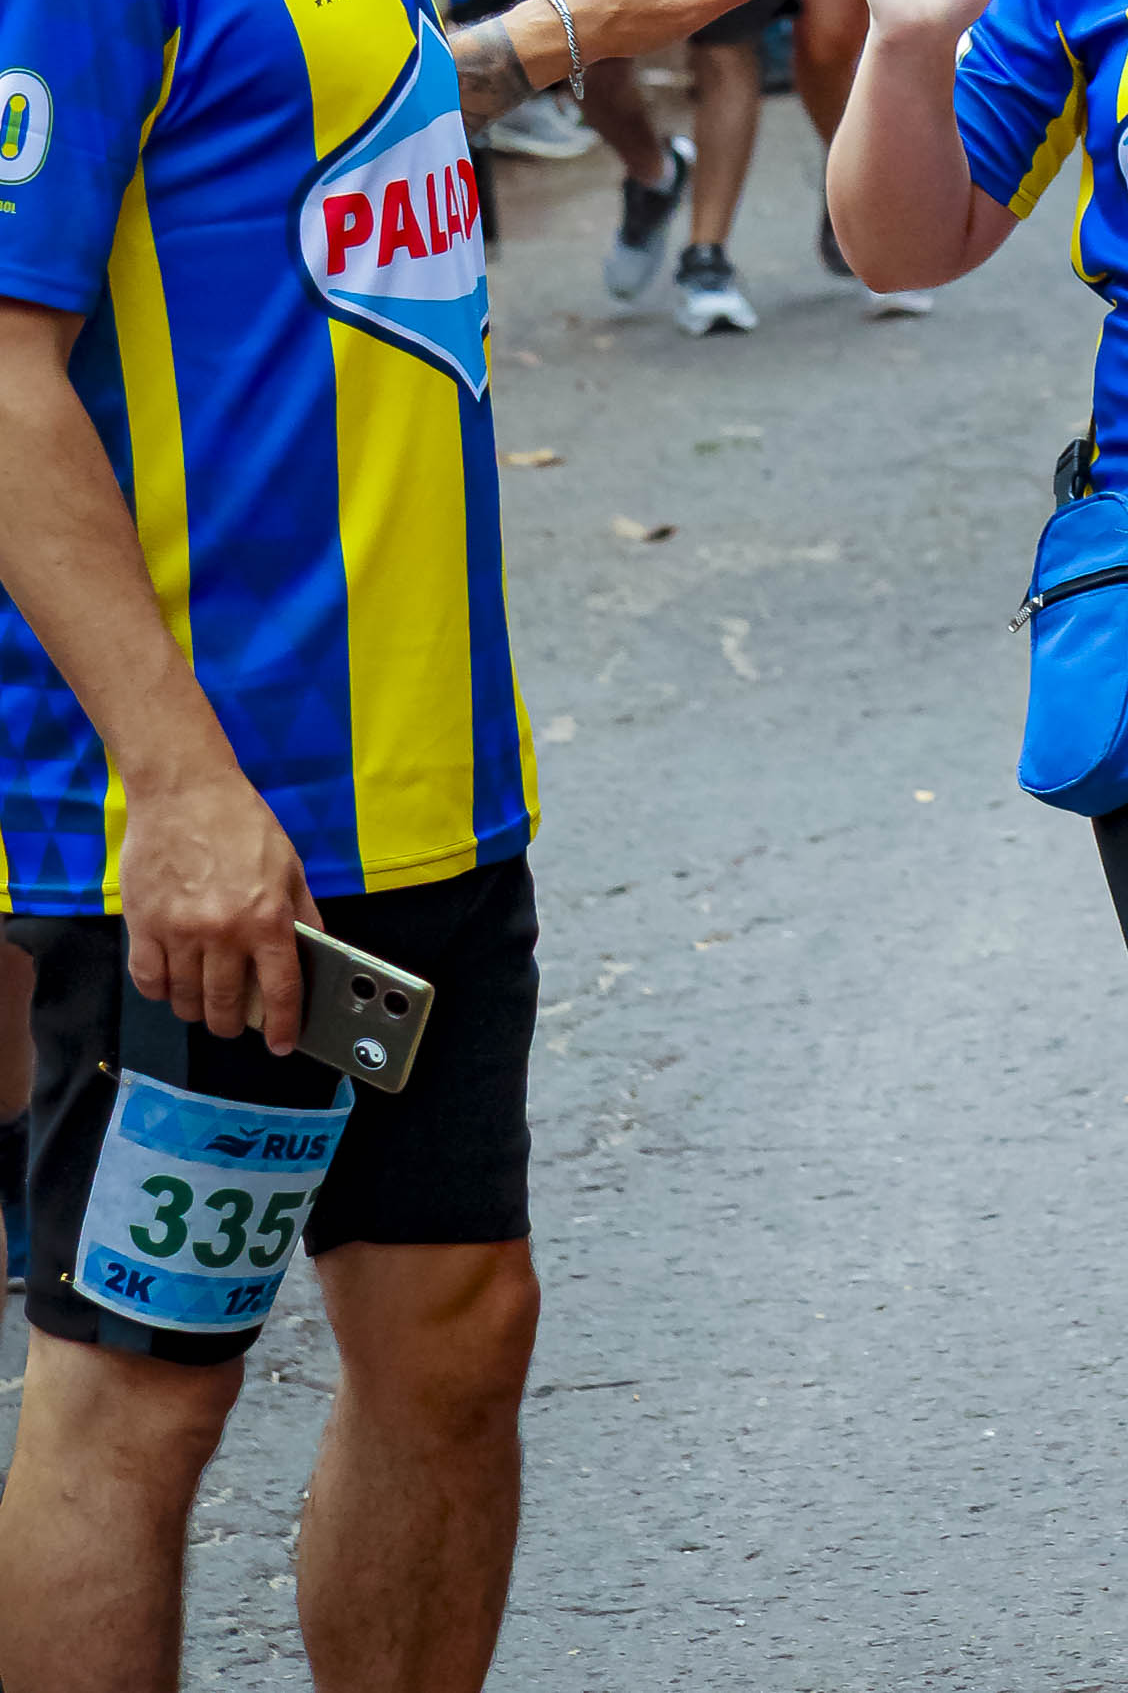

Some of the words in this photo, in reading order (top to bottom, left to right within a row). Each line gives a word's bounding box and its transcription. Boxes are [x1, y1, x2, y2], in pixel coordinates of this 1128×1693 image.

[262, 1133, 329, 1160] RUS
[129, 1174, 322, 1268] 335
[104, 1262, 156, 1303] 2K
